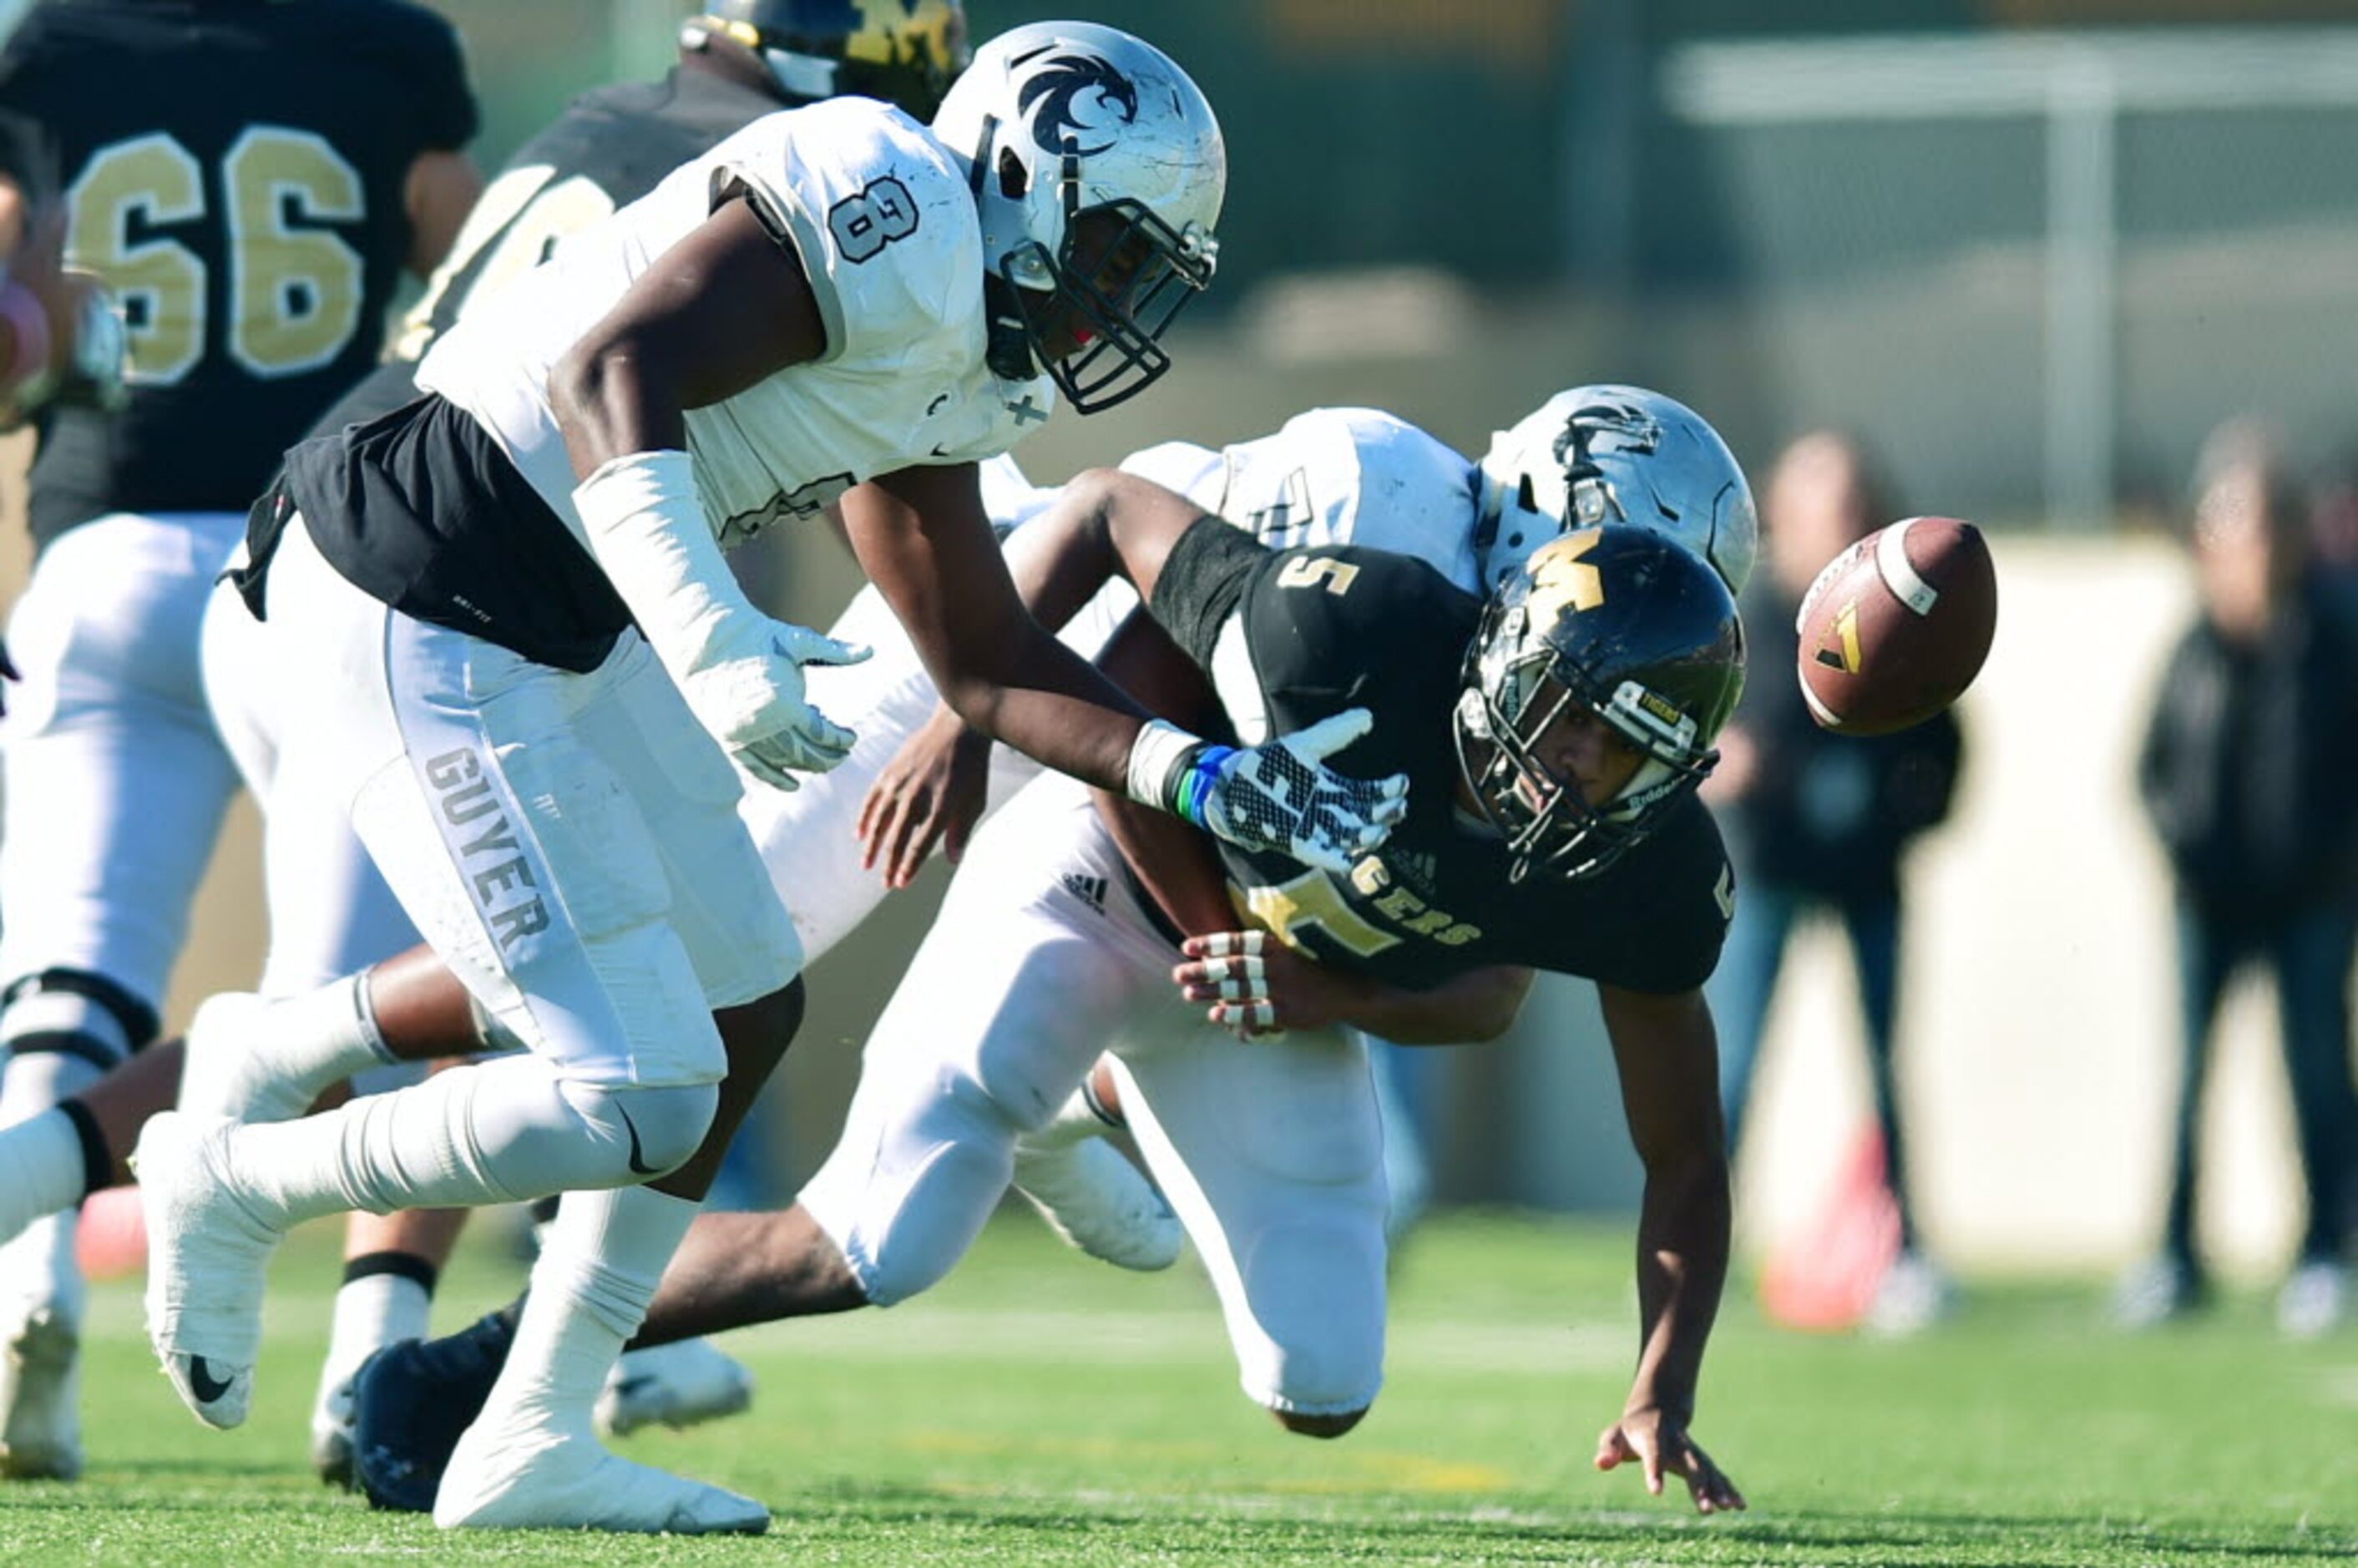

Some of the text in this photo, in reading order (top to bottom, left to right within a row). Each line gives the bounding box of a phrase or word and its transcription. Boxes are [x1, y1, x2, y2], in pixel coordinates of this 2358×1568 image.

[61, 125, 365, 384] 66
[827, 175, 919, 264] 8
[1277, 554, 1361, 596] 5
[1526, 526, 1605, 637] M
[425, 747, 551, 953] GUYER
